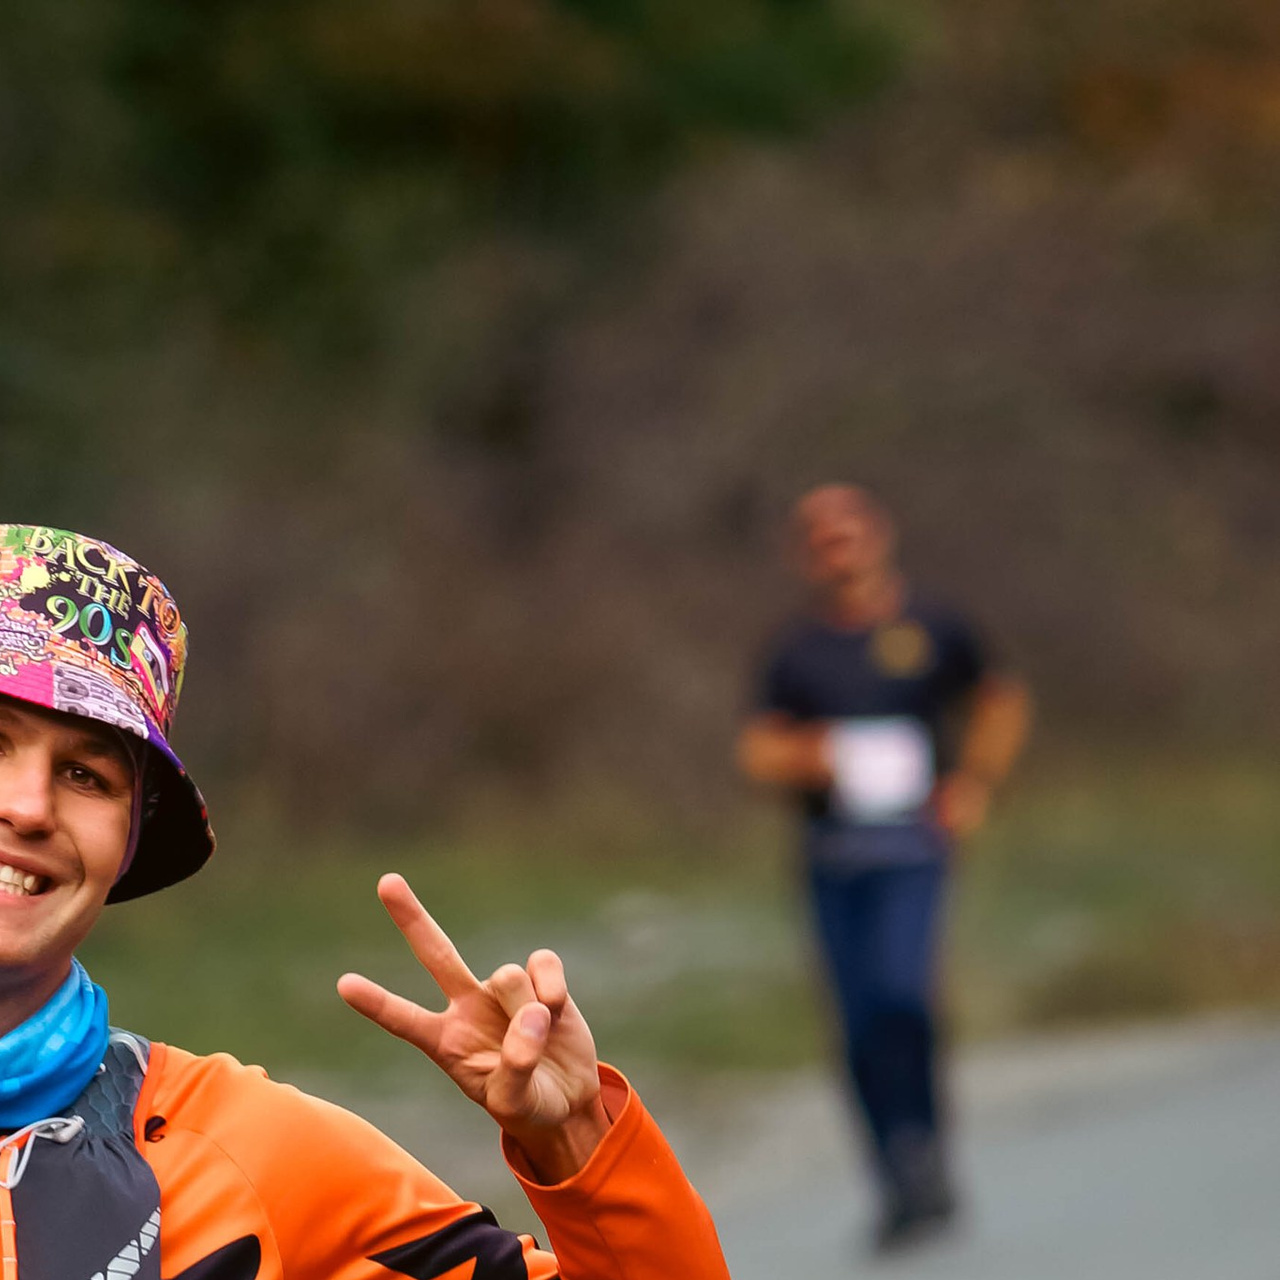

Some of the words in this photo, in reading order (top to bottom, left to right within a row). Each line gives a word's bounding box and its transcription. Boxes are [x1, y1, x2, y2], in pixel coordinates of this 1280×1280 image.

[26, 526, 139, 592] BACK
[136, 574, 181, 637] TO
[74, 569, 133, 621] THE
